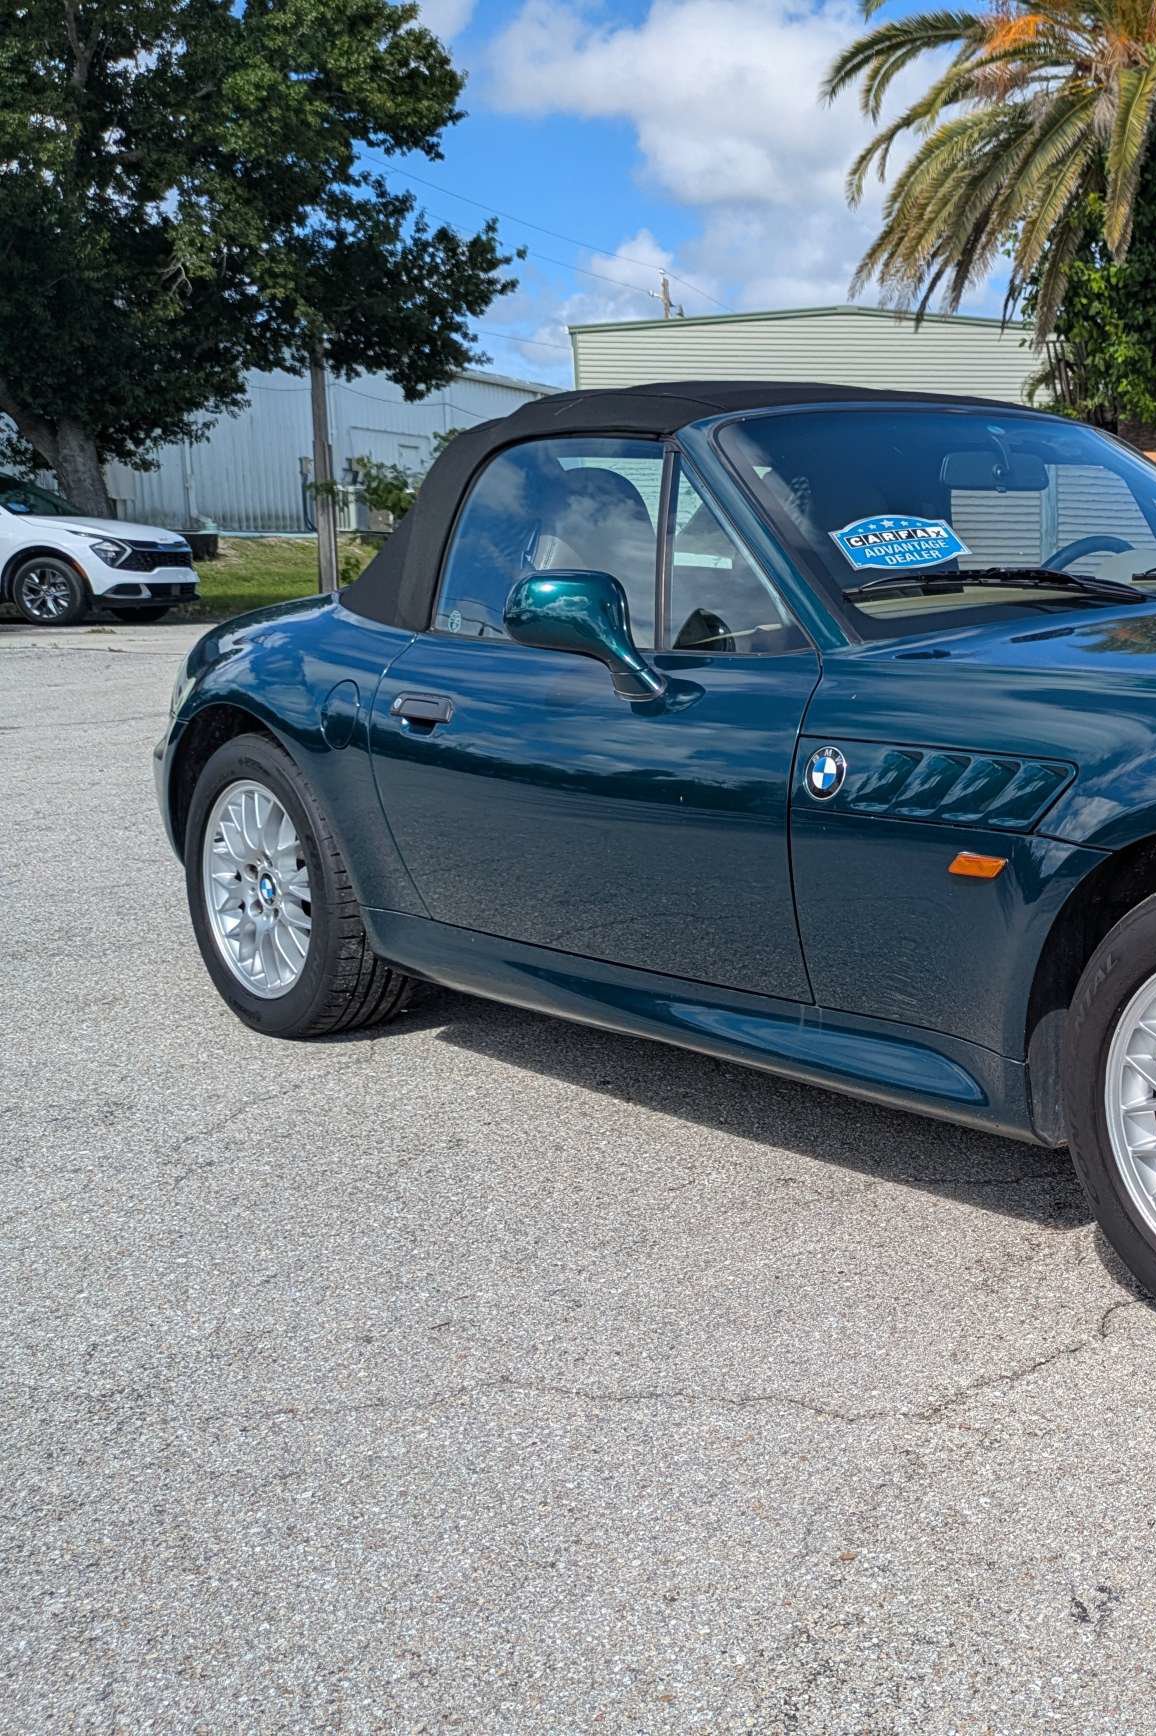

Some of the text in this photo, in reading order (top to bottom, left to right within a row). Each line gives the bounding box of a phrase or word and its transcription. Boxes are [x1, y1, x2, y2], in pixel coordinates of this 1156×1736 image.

[848, 528, 947, 547] CARFAX
[864, 539, 949, 558] ADVANTAGE
[885, 550, 942, 565] DEALER
[811, 748, 844, 766] BMW
